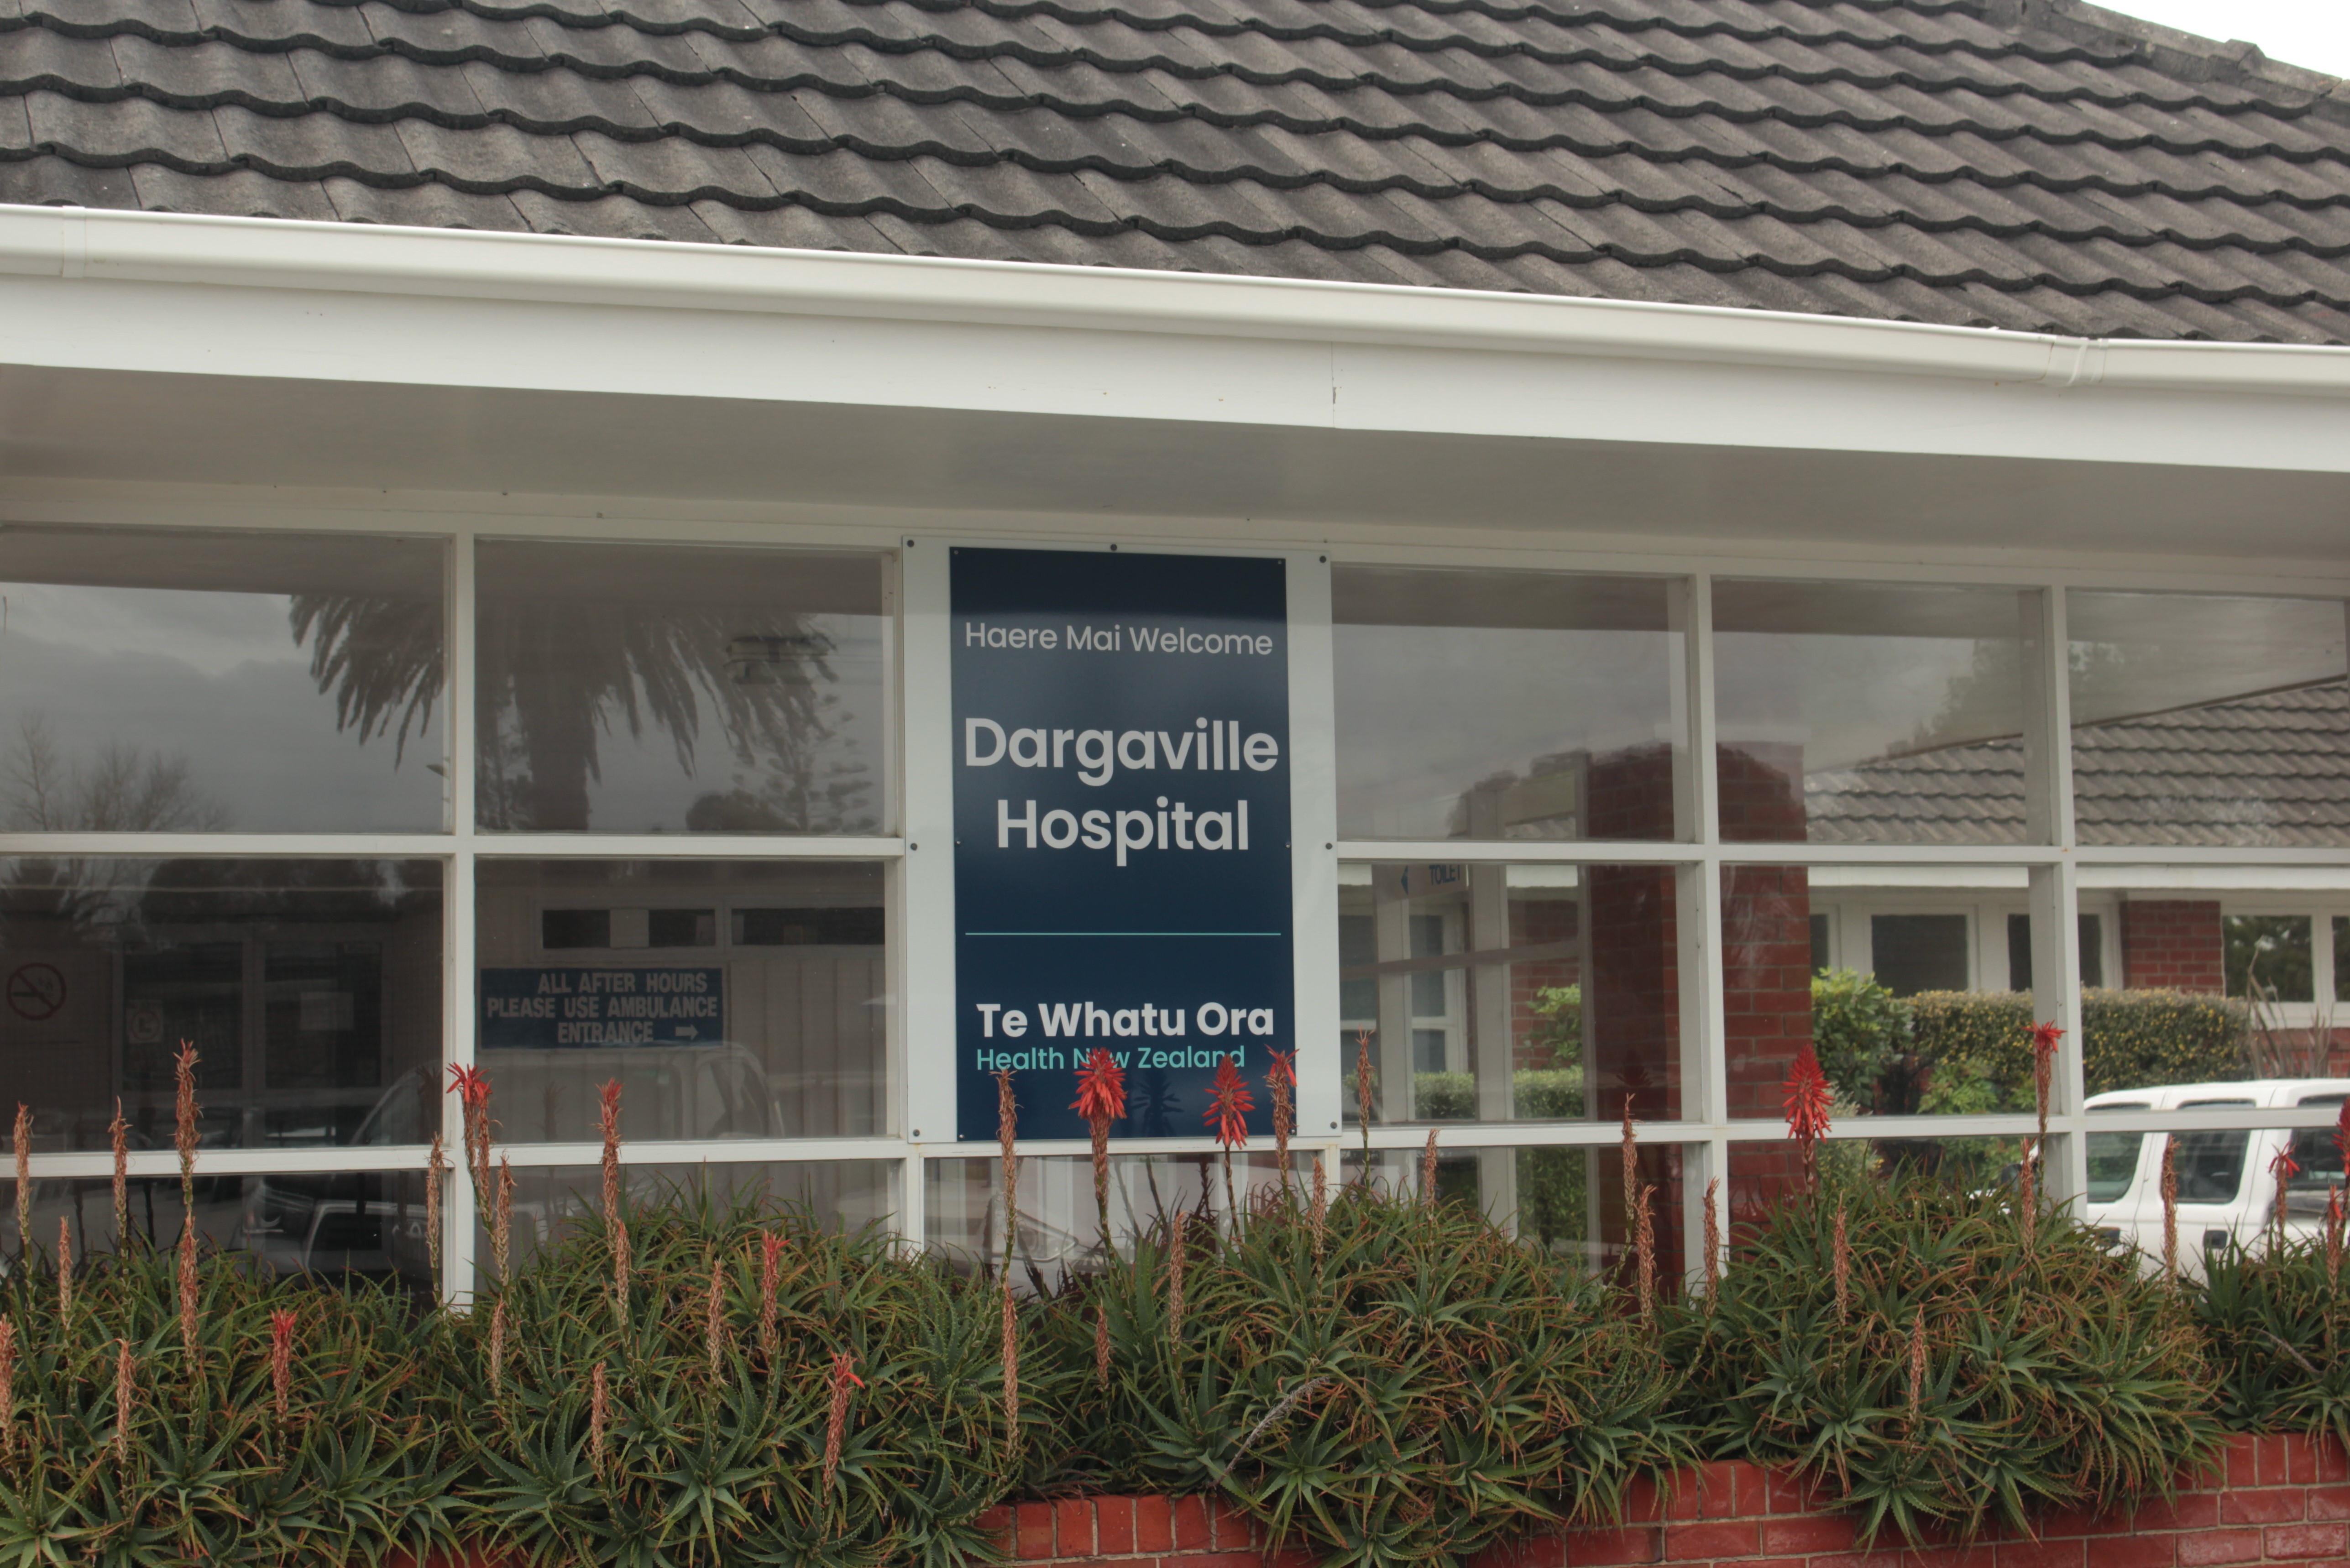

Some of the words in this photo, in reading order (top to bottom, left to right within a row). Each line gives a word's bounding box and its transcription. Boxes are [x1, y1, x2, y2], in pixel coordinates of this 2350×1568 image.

[965, 622, 1058, 649] Haere
[1066, 625, 1121, 651] Mai
[1129, 627, 1273, 655] Welcome
[965, 717, 1278, 787] Dargaville
[998, 796, 1248, 867] Hospital
[537, 973, 572, 994] ALL
[578, 972, 636, 993] AFTER
[646, 972, 708, 993] HOURS
[487, 997, 555, 1018] PLEASE
[564, 997, 599, 1018] USE
[607, 996, 717, 1018] AMBULANCE
[976, 1004, 1028, 1037] Te
[1038, 1001, 1185, 1037] Whatu
[1197, 1002, 1274, 1035] Ora
[558, 1022, 654, 1043] ENTRANCE
[976, 1047, 1065, 1071] Health
[1073, 1048, 1131, 1069] Nw
[1138, 1045, 1245, 1068] Zealand
